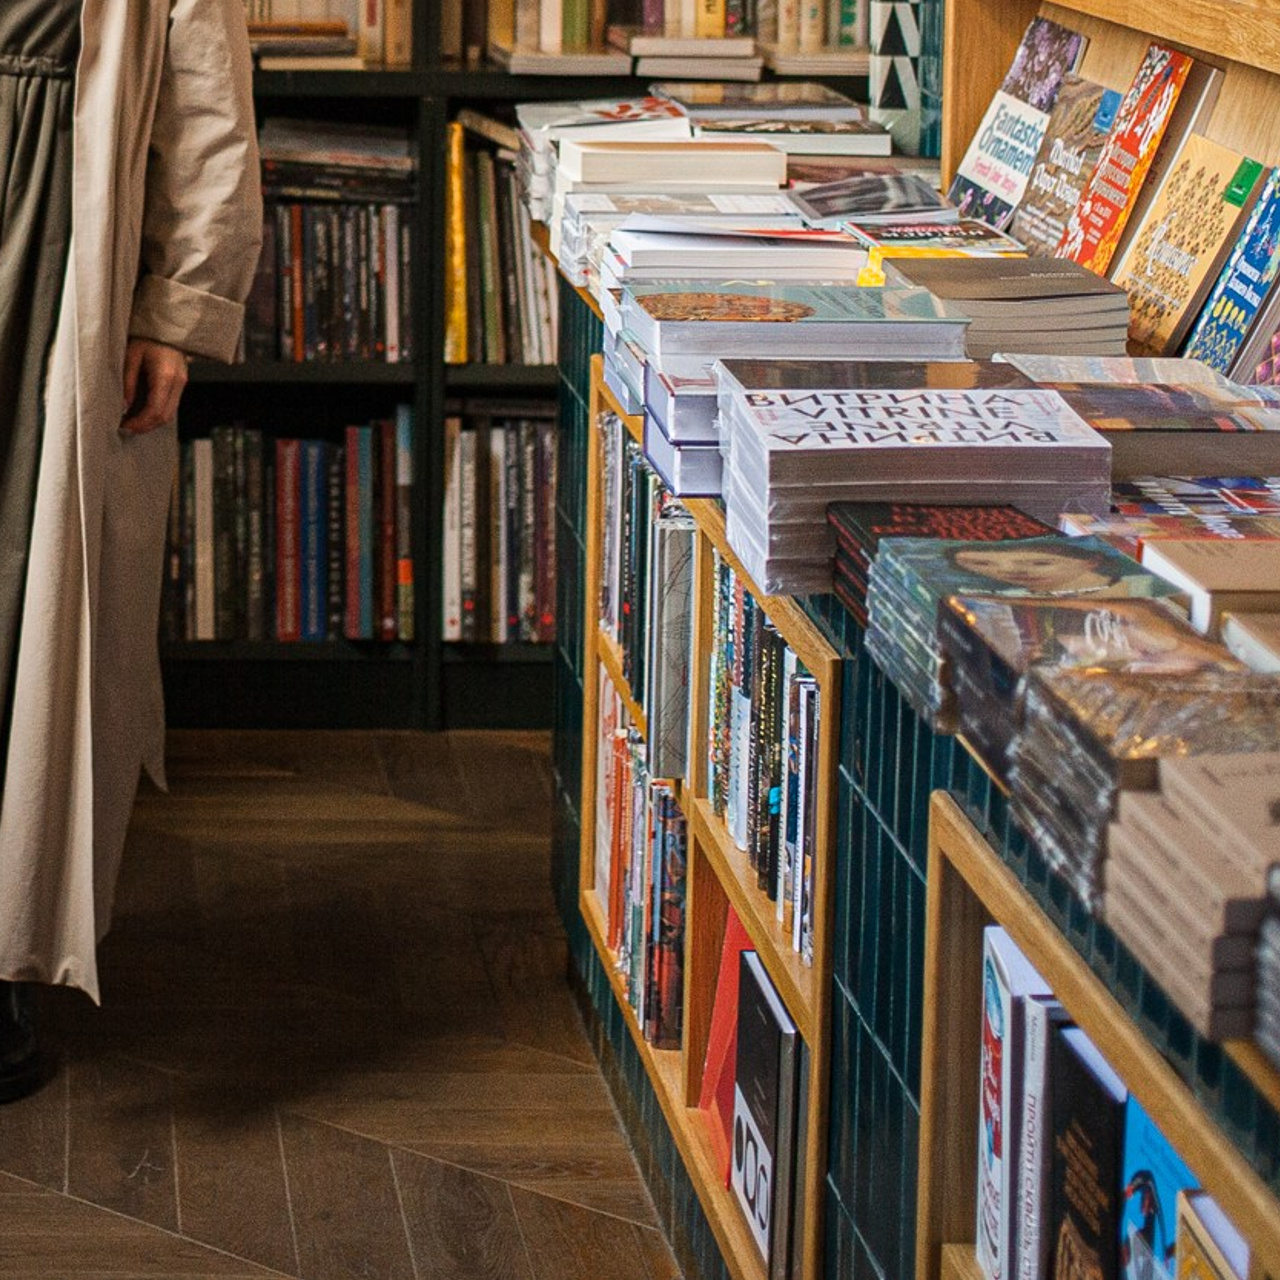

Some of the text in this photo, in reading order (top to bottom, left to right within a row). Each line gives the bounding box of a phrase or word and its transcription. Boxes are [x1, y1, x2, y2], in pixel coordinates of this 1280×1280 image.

[992, 103, 1045, 153] Fantastic
[744, 393, 1024, 407] ВИТРИНА
[793, 406, 1019, 420] VITRINE
[1026, 1094, 1038, 1171] ПРОЙТИ
[1023, 1176, 1035, 1251] СКВОЗЬ
